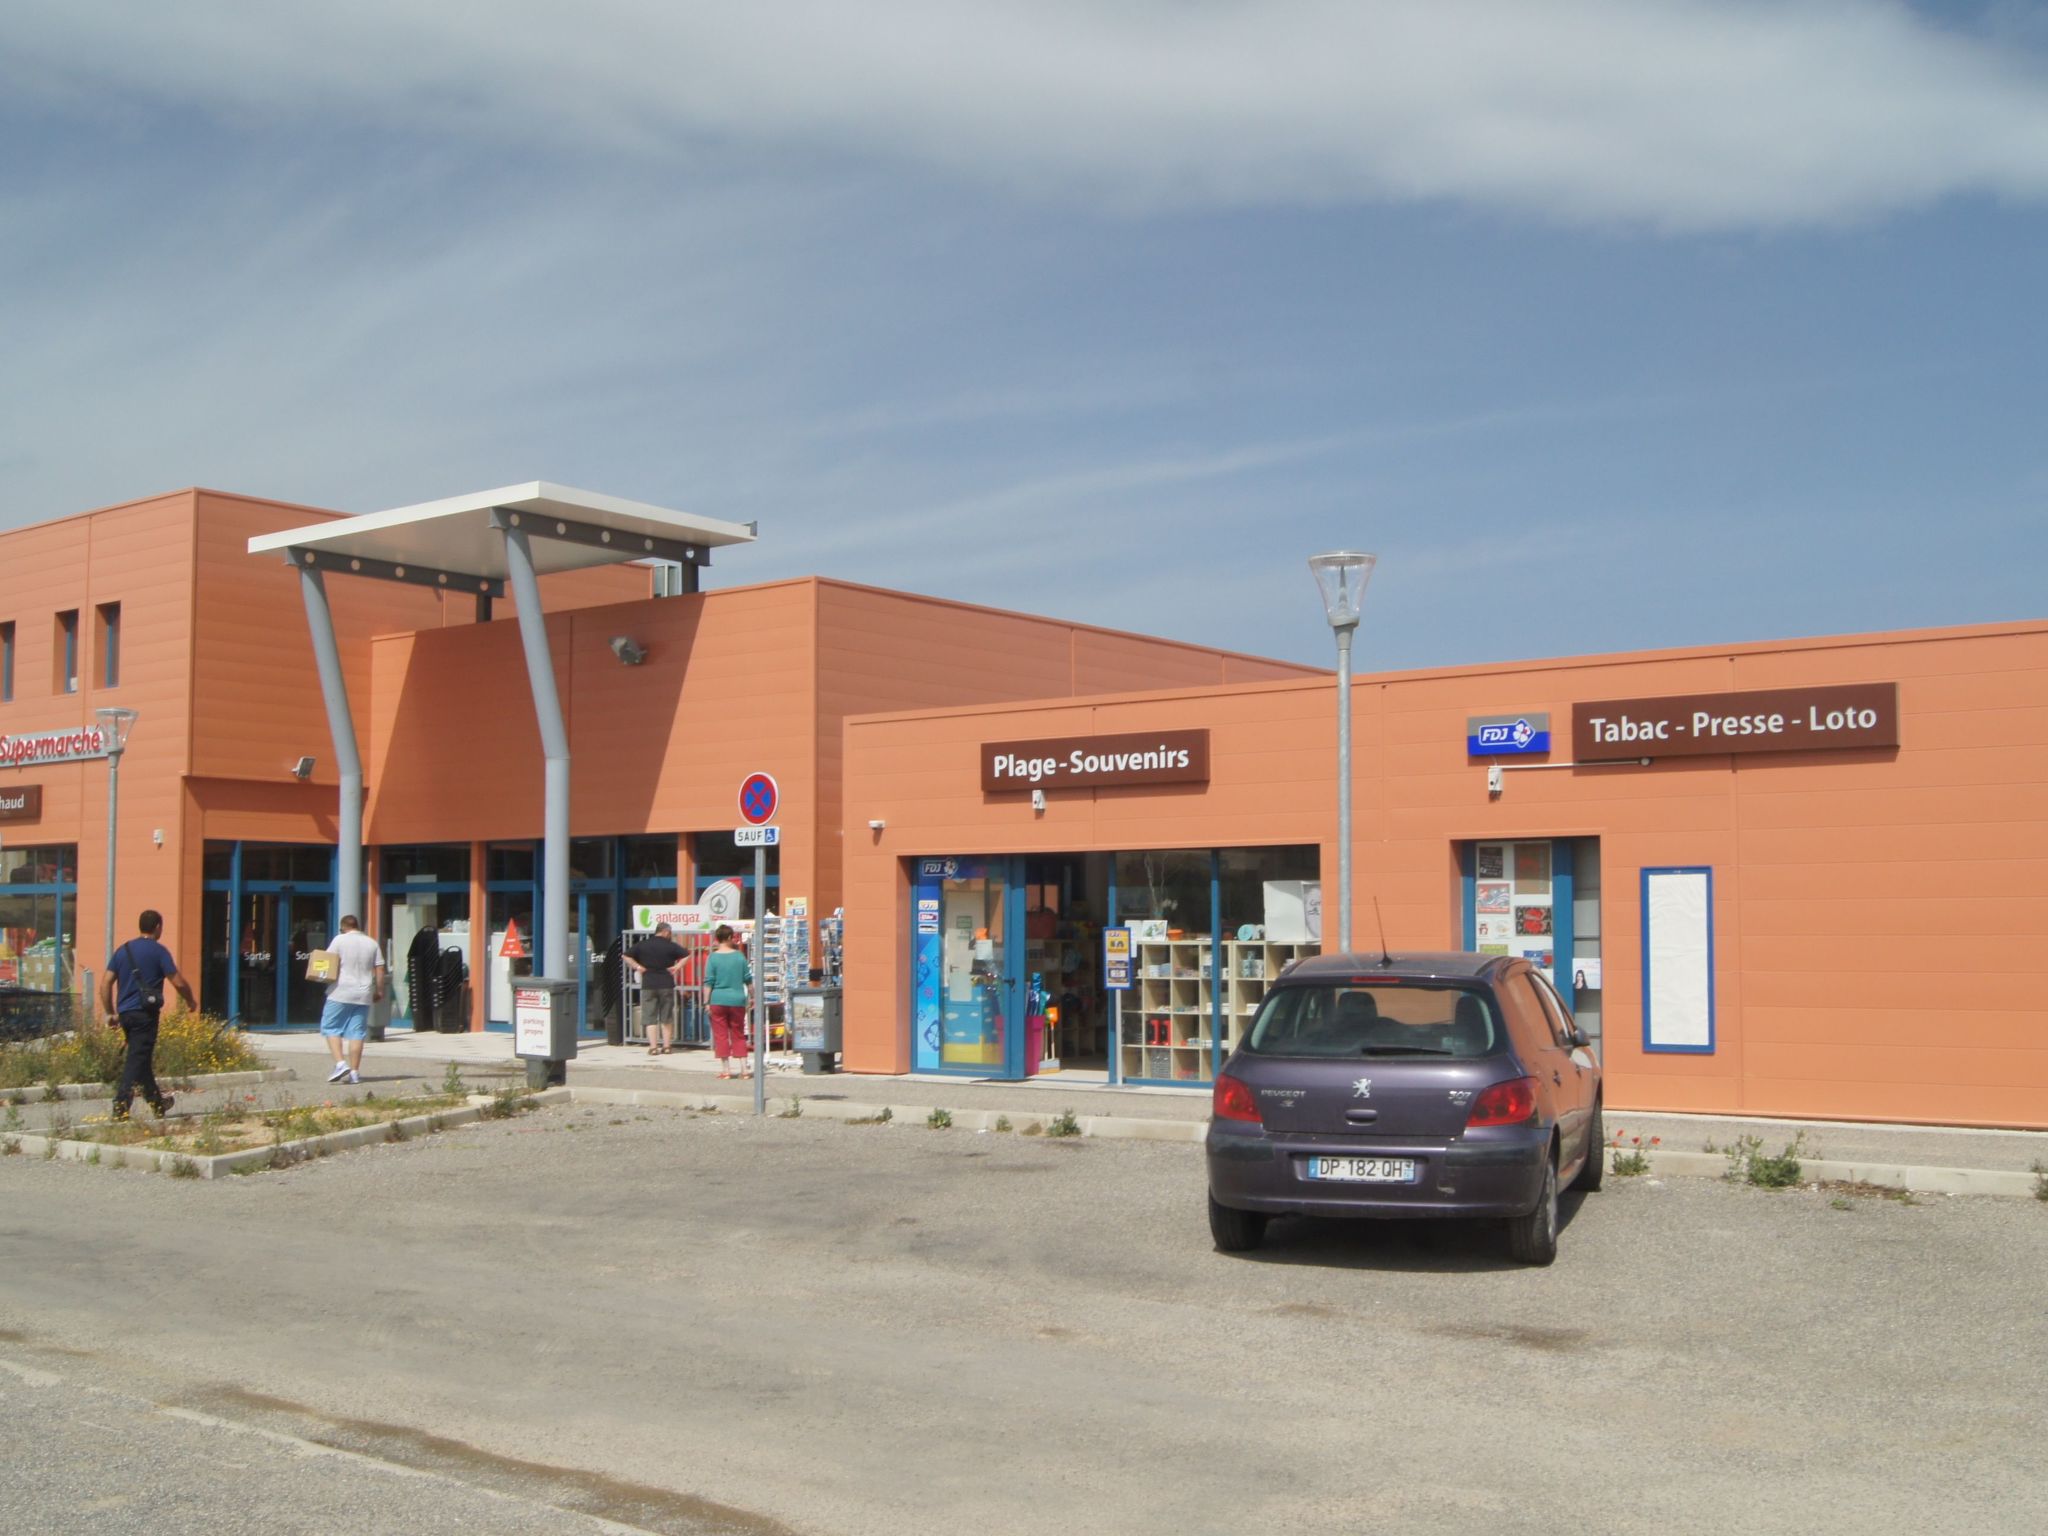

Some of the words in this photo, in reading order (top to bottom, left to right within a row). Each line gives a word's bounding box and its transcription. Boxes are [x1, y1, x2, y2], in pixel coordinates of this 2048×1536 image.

[1589, 716, 1669, 743] Tabac
[1692, 711, 1784, 737] Presse
[1809, 705, 1877, 731] Loto
[1482, 727, 1509, 742] FDJ
[0, 724, 101, 767] Supermarché
[737, 830, 763, 842] SAUF
[924, 863, 942, 873] FDJ
[655, 912, 701, 926] antargaz
[244, 950, 271, 961] Sortie
[295, 950, 310, 961] Sor
[1261, 1089, 1307, 1099] PEUGEOT
[1448, 1090, 1473, 1101] 307
